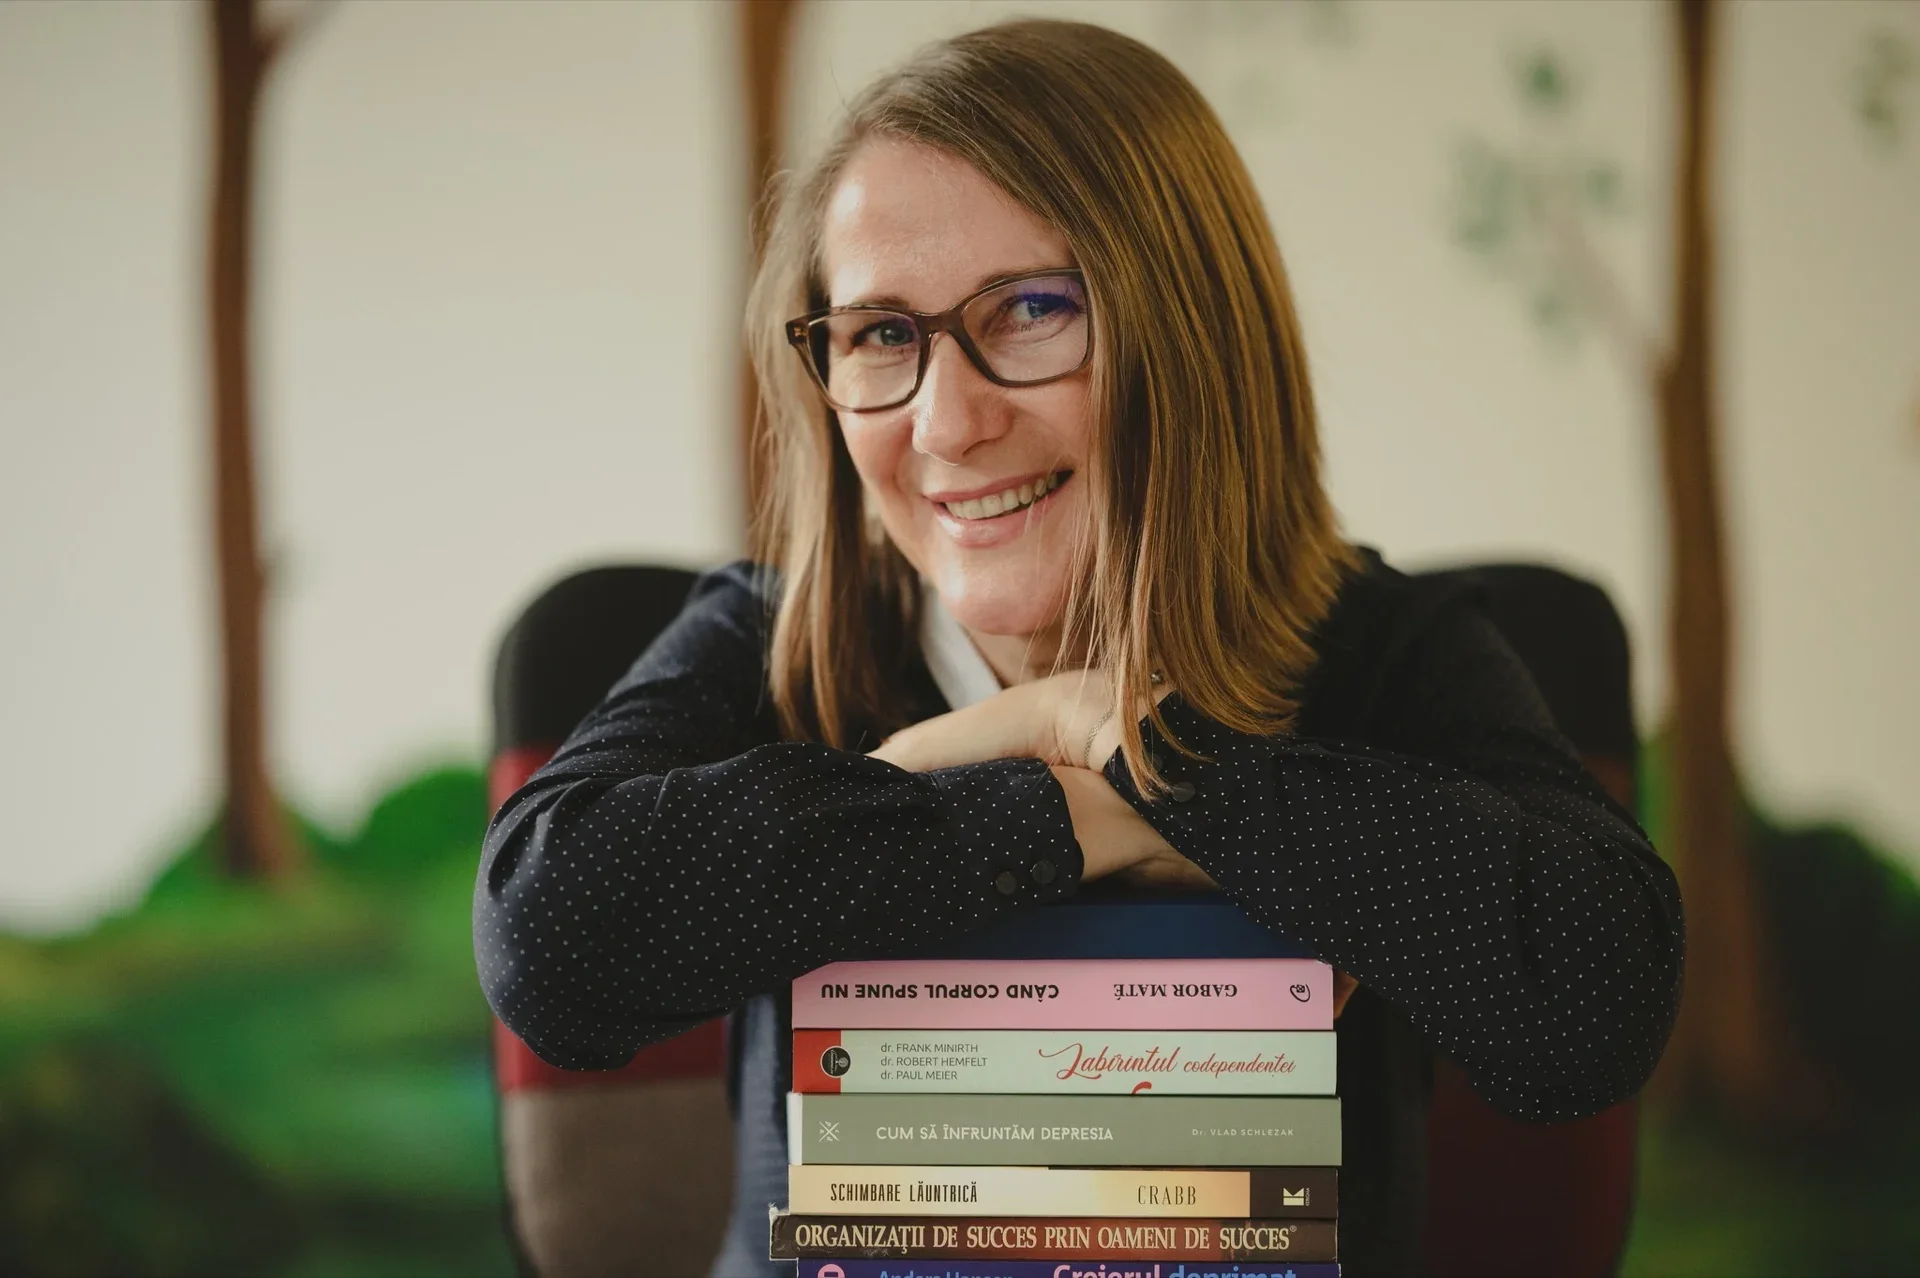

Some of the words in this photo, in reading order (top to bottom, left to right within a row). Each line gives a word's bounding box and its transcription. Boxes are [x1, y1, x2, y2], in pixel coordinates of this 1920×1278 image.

[822, 984, 848, 998] NU
[855, 984, 917, 998] SPUNE
[924, 984, 999, 998] CORPUL
[1006, 984, 1059, 1002] CÂND
[1114, 984, 1166, 1000] MATÉ
[1172, 984, 1237, 997] GABOR
[881, 1043, 893, 1052] dr.
[897, 1043, 931, 1052] FRANK
[934, 1044, 978, 1052] MINIRTH
[881, 1056, 893, 1066] dr.
[897, 1057, 938, 1066] ROBERT
[941, 1058, 987, 1066] HEMFELT
[1039, 1043, 1180, 1080] Labirintul
[881, 1070, 893, 1079] dr.
[897, 1071, 923, 1079] PAUL
[926, 1071, 957, 1080] MEIER
[877, 1127, 913, 1139] CUM
[920, 1124, 937, 1139] SĂ
[943, 1124, 1034, 1140] ÎNFRUNTĂM
[1042, 1127, 1113, 1140] DEPRESIA
[831, 1184, 900, 1201] SCHIMBARE
[910, 1181, 977, 1202] LĂUNTRICĂ
[1138, 1186, 1196, 1205] CRABB
[933, 1226, 958, 1247] DE
[967, 1226, 1037, 1248] SUCCES
[1045, 1227, 1090, 1248] PRIN
[1097, 1227, 1176, 1249] OAMENI
[1184, 1228, 1209, 1249] DE
